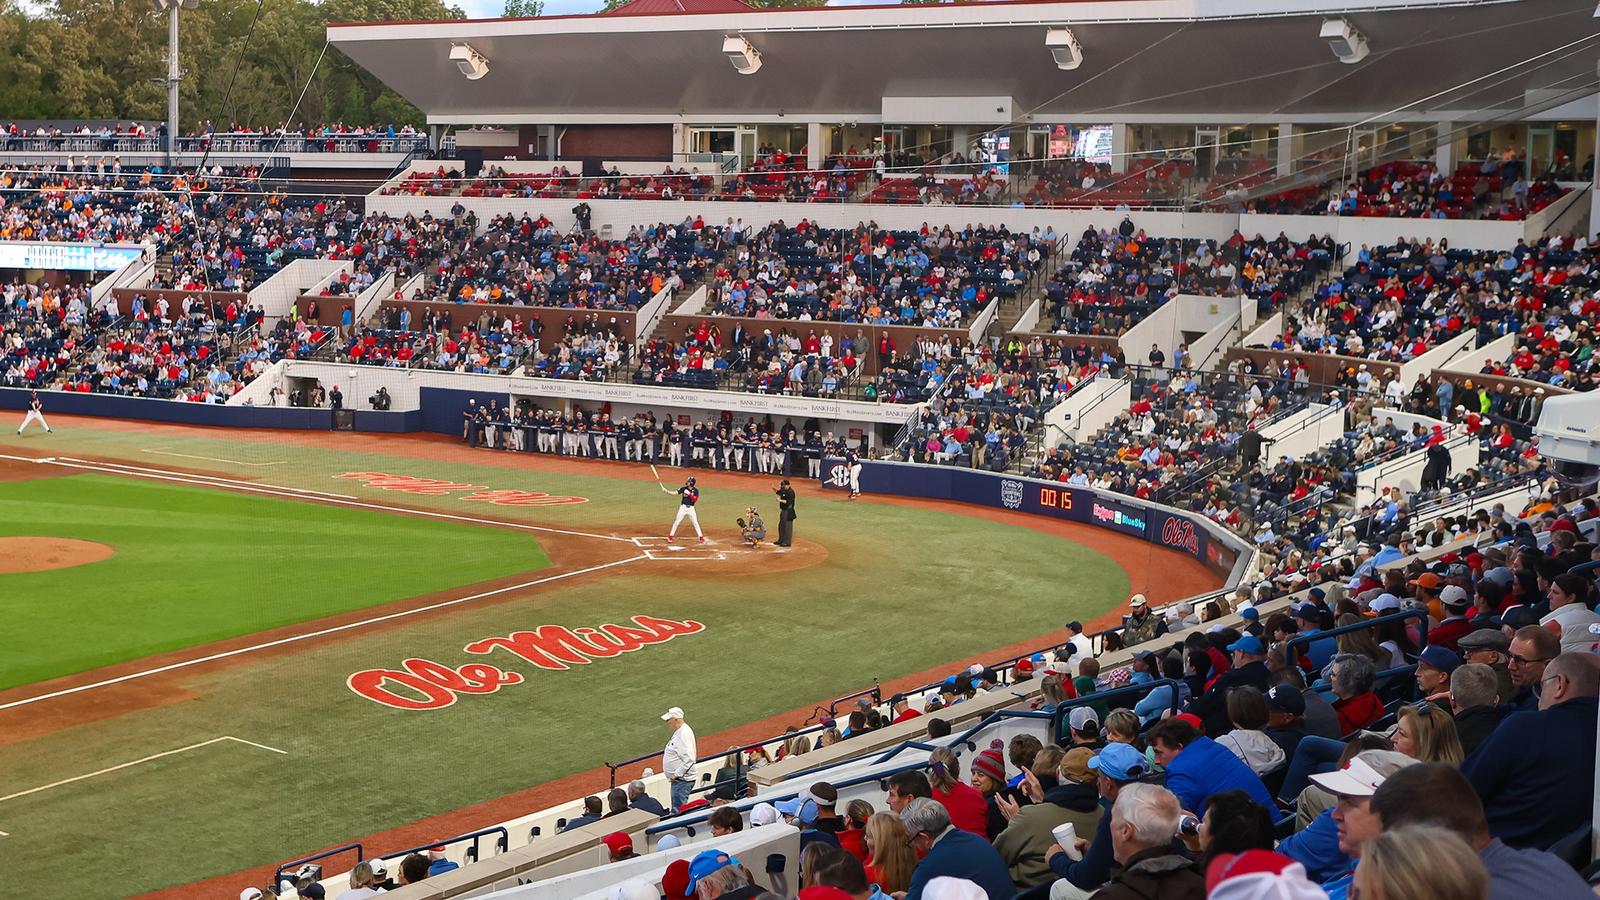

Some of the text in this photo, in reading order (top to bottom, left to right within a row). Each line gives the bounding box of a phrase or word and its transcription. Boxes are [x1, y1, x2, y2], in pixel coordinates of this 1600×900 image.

[1040, 488, 1057, 507] 00
[1061, 491, 1072, 509] 15
[1122, 514, 1146, 531] BlueSky
[1162, 516, 1184, 545] Ole
[346, 615, 706, 711] Ole Miss
